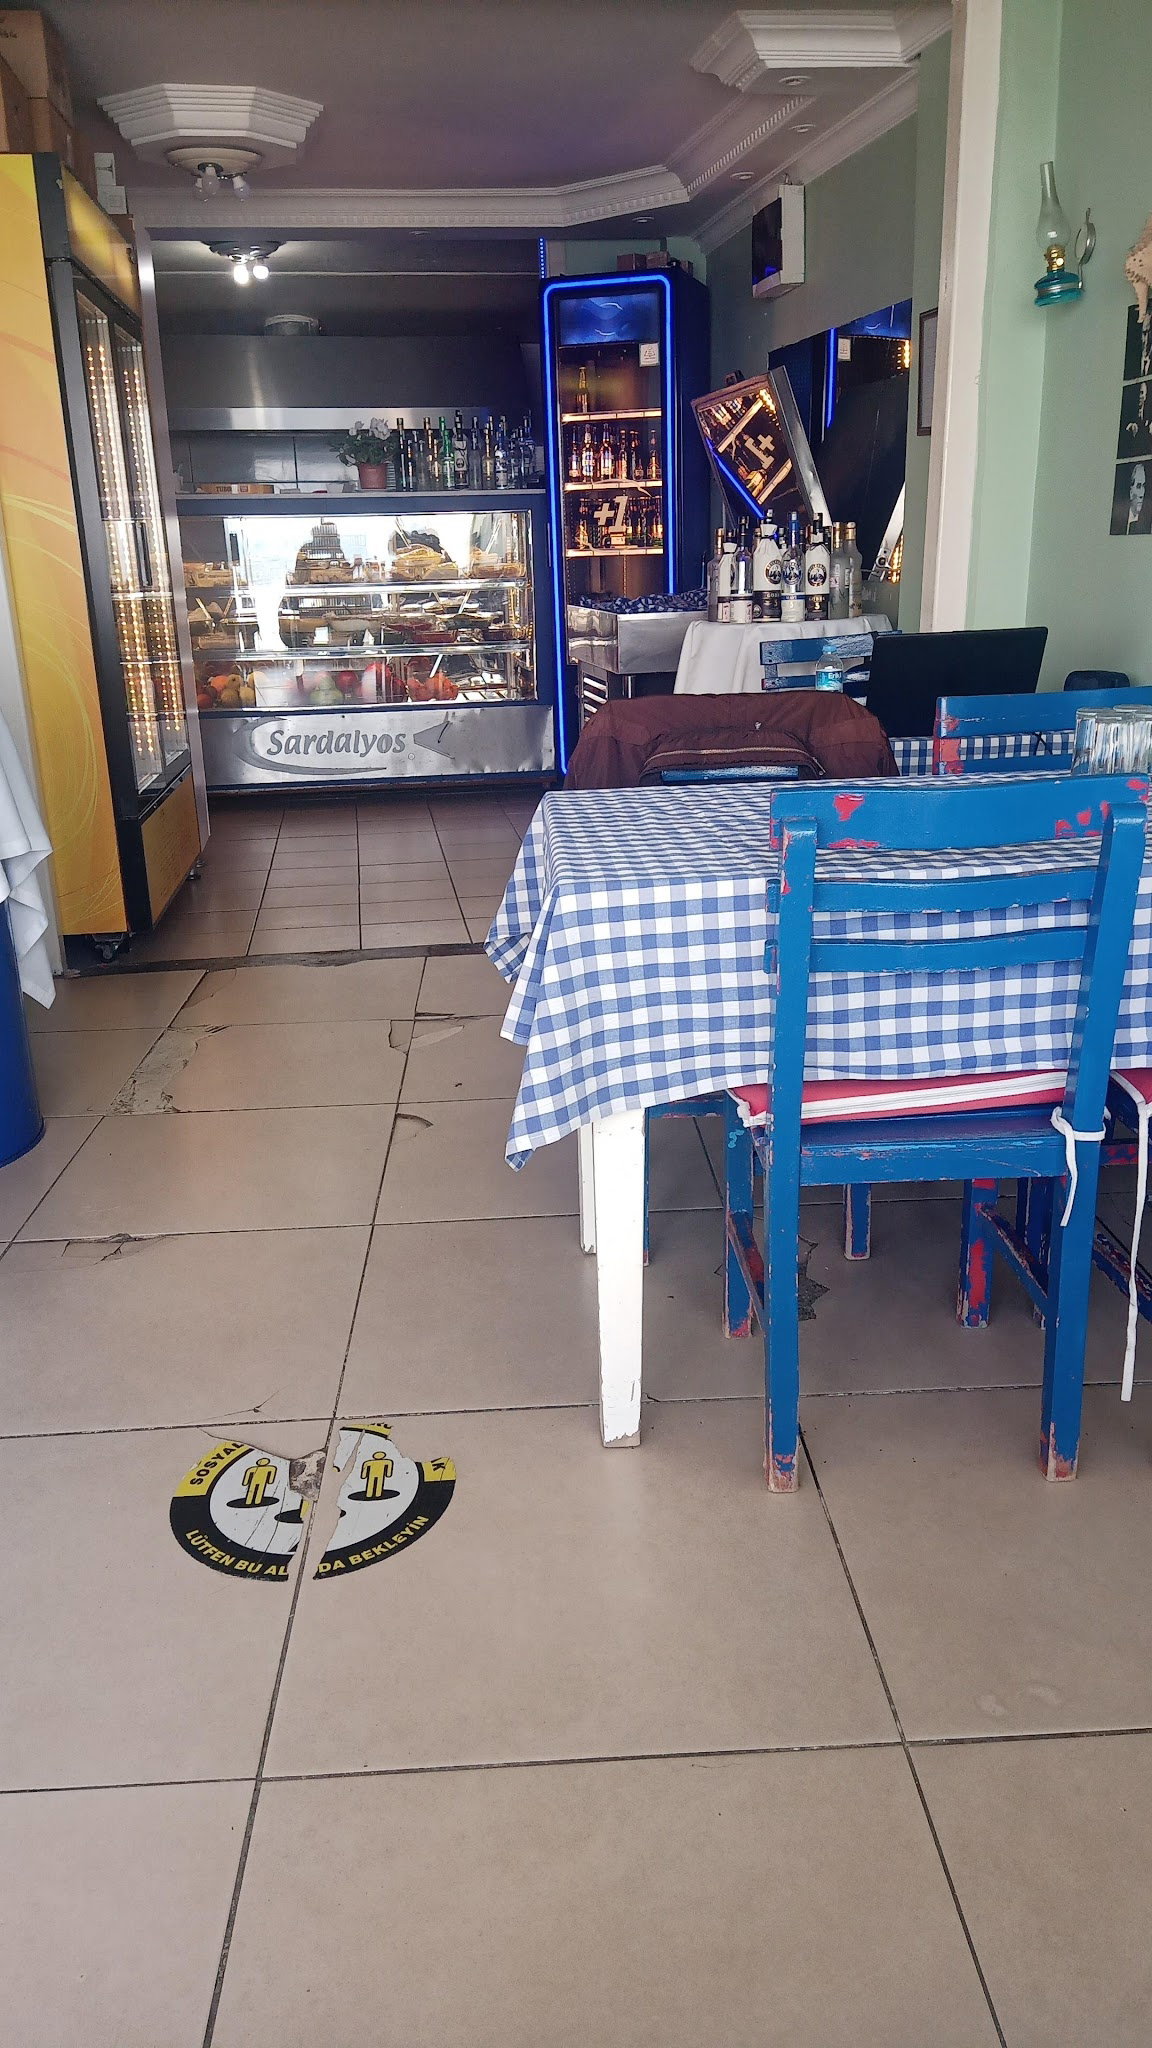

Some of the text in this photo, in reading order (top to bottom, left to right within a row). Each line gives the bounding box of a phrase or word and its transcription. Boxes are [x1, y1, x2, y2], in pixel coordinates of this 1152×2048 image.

[266, 730, 406, 757] Sardalyos
[189, 1442, 245, 1486] SOSYAL
[185, 1529, 236, 1567] LÜTFEN
[233, 1559, 263, 1573] BU
[348, 1515, 430, 1566] BEKLEYİN
